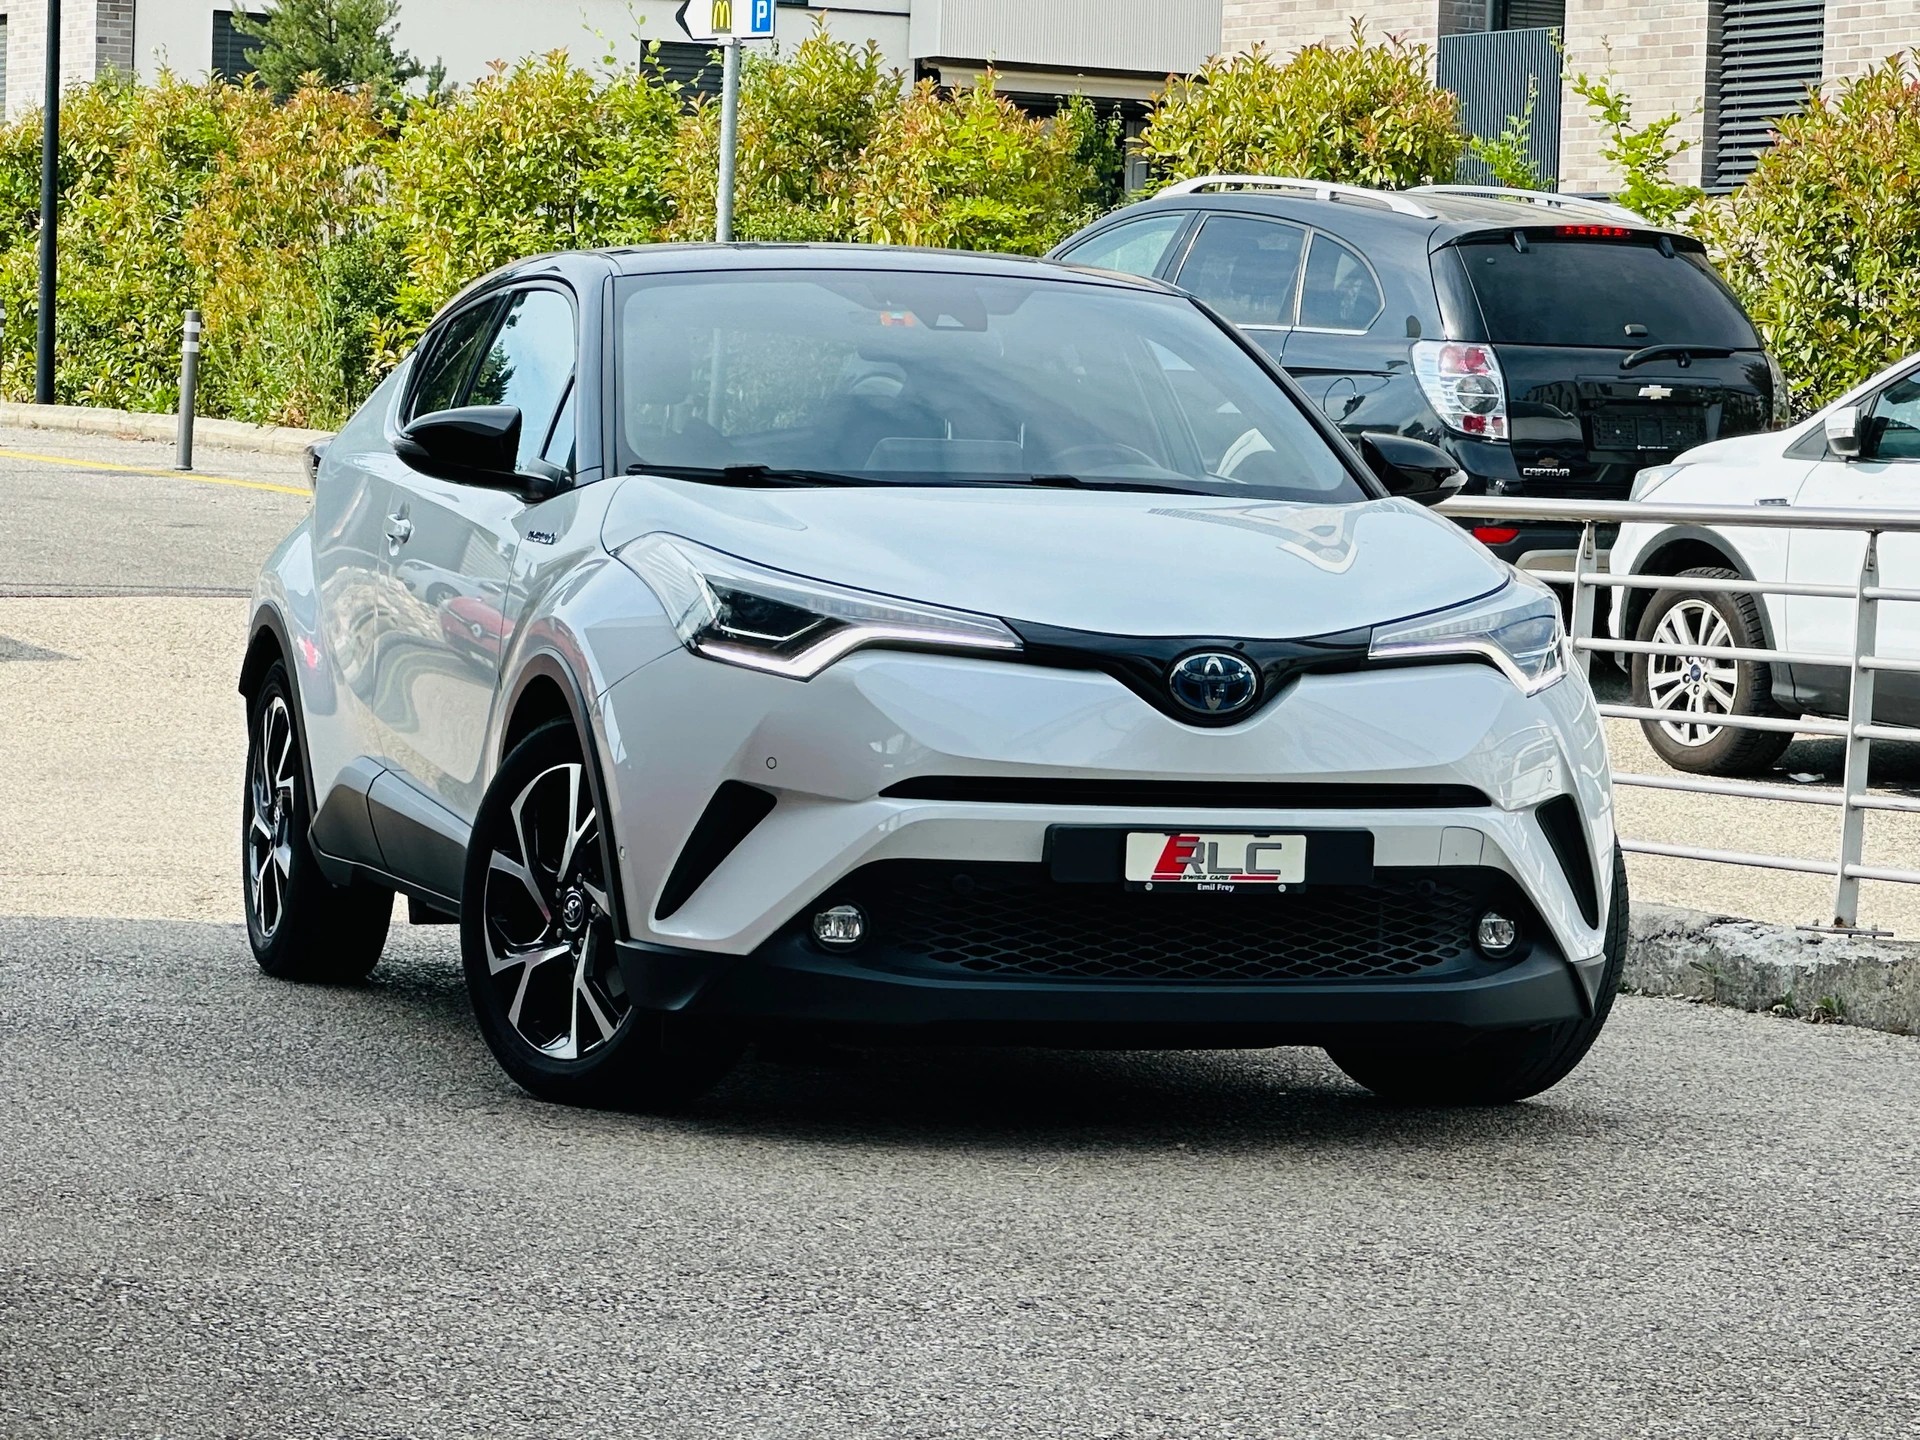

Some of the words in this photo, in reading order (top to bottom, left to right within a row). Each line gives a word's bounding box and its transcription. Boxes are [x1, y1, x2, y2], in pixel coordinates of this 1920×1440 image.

[756, 0, 768, 29] P
[1523, 467, 1570, 477] CAPTIVA
[1197, 883, 1216, 891] Emil
[1217, 883, 1235, 892] Frey
